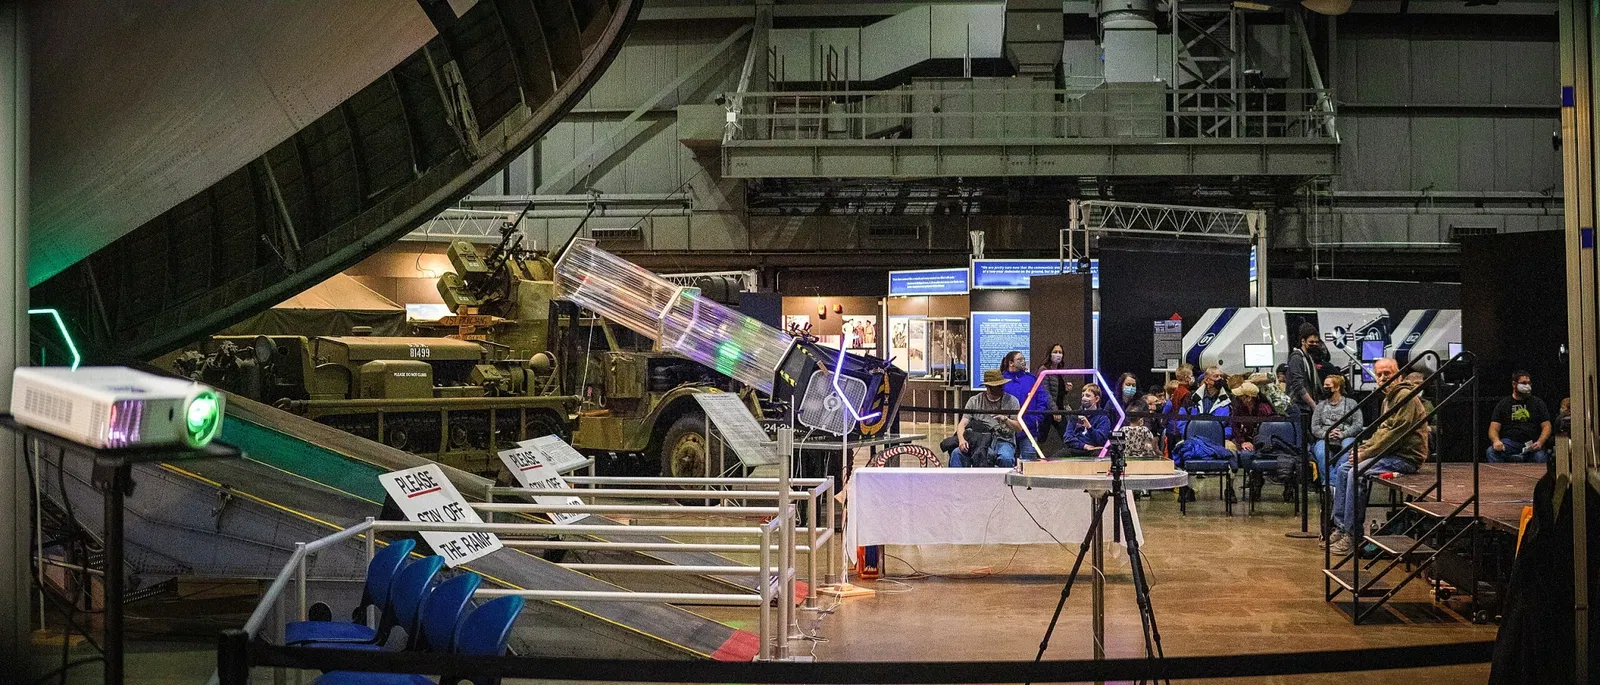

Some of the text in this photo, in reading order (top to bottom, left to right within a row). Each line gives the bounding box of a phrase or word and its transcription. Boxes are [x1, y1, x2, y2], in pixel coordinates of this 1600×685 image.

[410, 348, 430, 358] 81499
[508, 450, 540, 468] PLEASE
[394, 470, 438, 494] PLEASE
[416, 502, 466, 522] STAY OFF
[439, 532, 493, 561] THE RAMP
